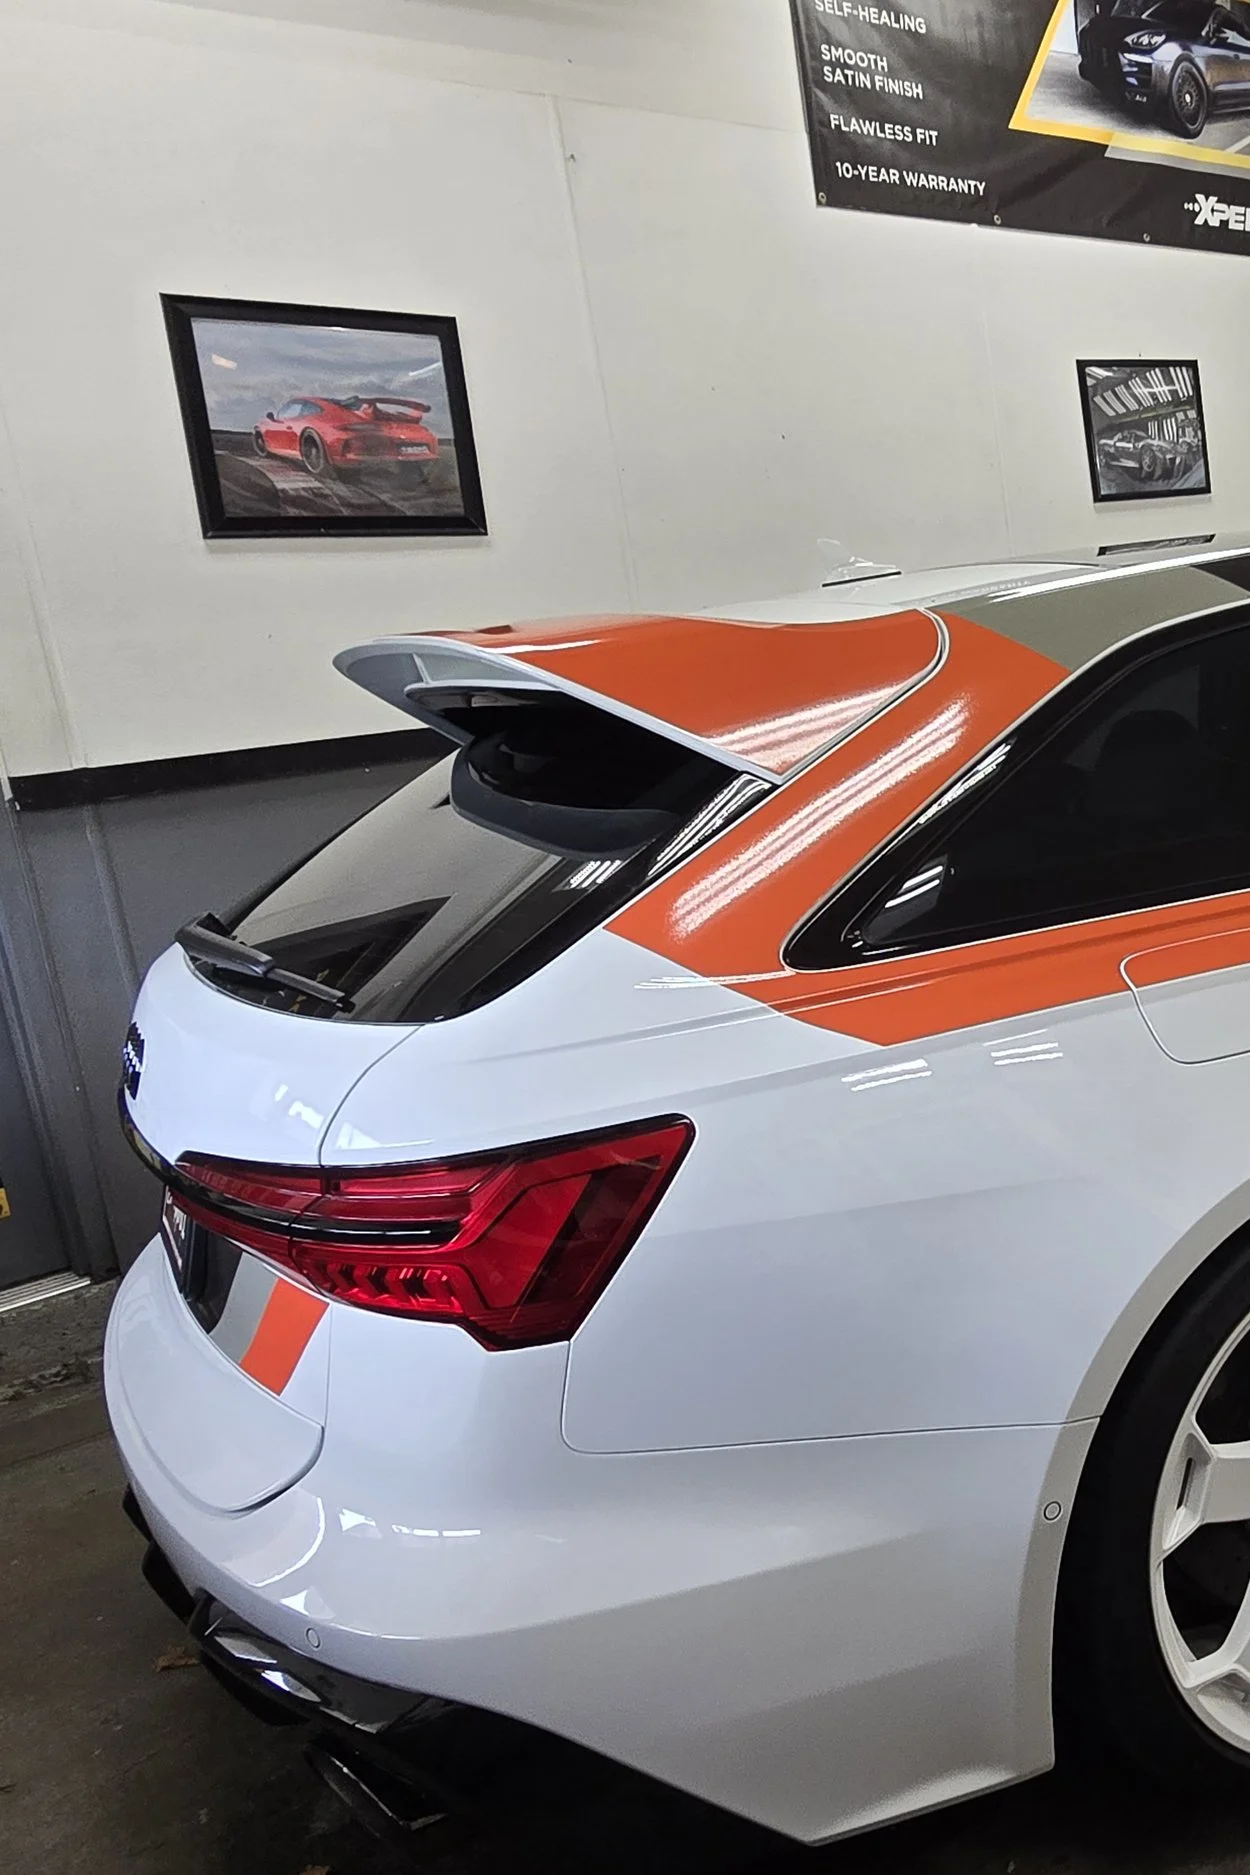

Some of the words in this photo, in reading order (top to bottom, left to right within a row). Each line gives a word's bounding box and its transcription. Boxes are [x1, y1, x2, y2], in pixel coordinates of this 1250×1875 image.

[815, 0, 927, 34] SELF-HEALING
[820, 43, 889, 73] SMOOTH
[823, 65, 872, 90] SATIN
[874, 74, 924, 100] FINISH
[829, 113, 913, 143] FLAWLESS
[915, 127, 939, 147] FIT
[835, 161, 900, 185] 10-YEAR
[902, 169, 986, 197] WARRANTY
